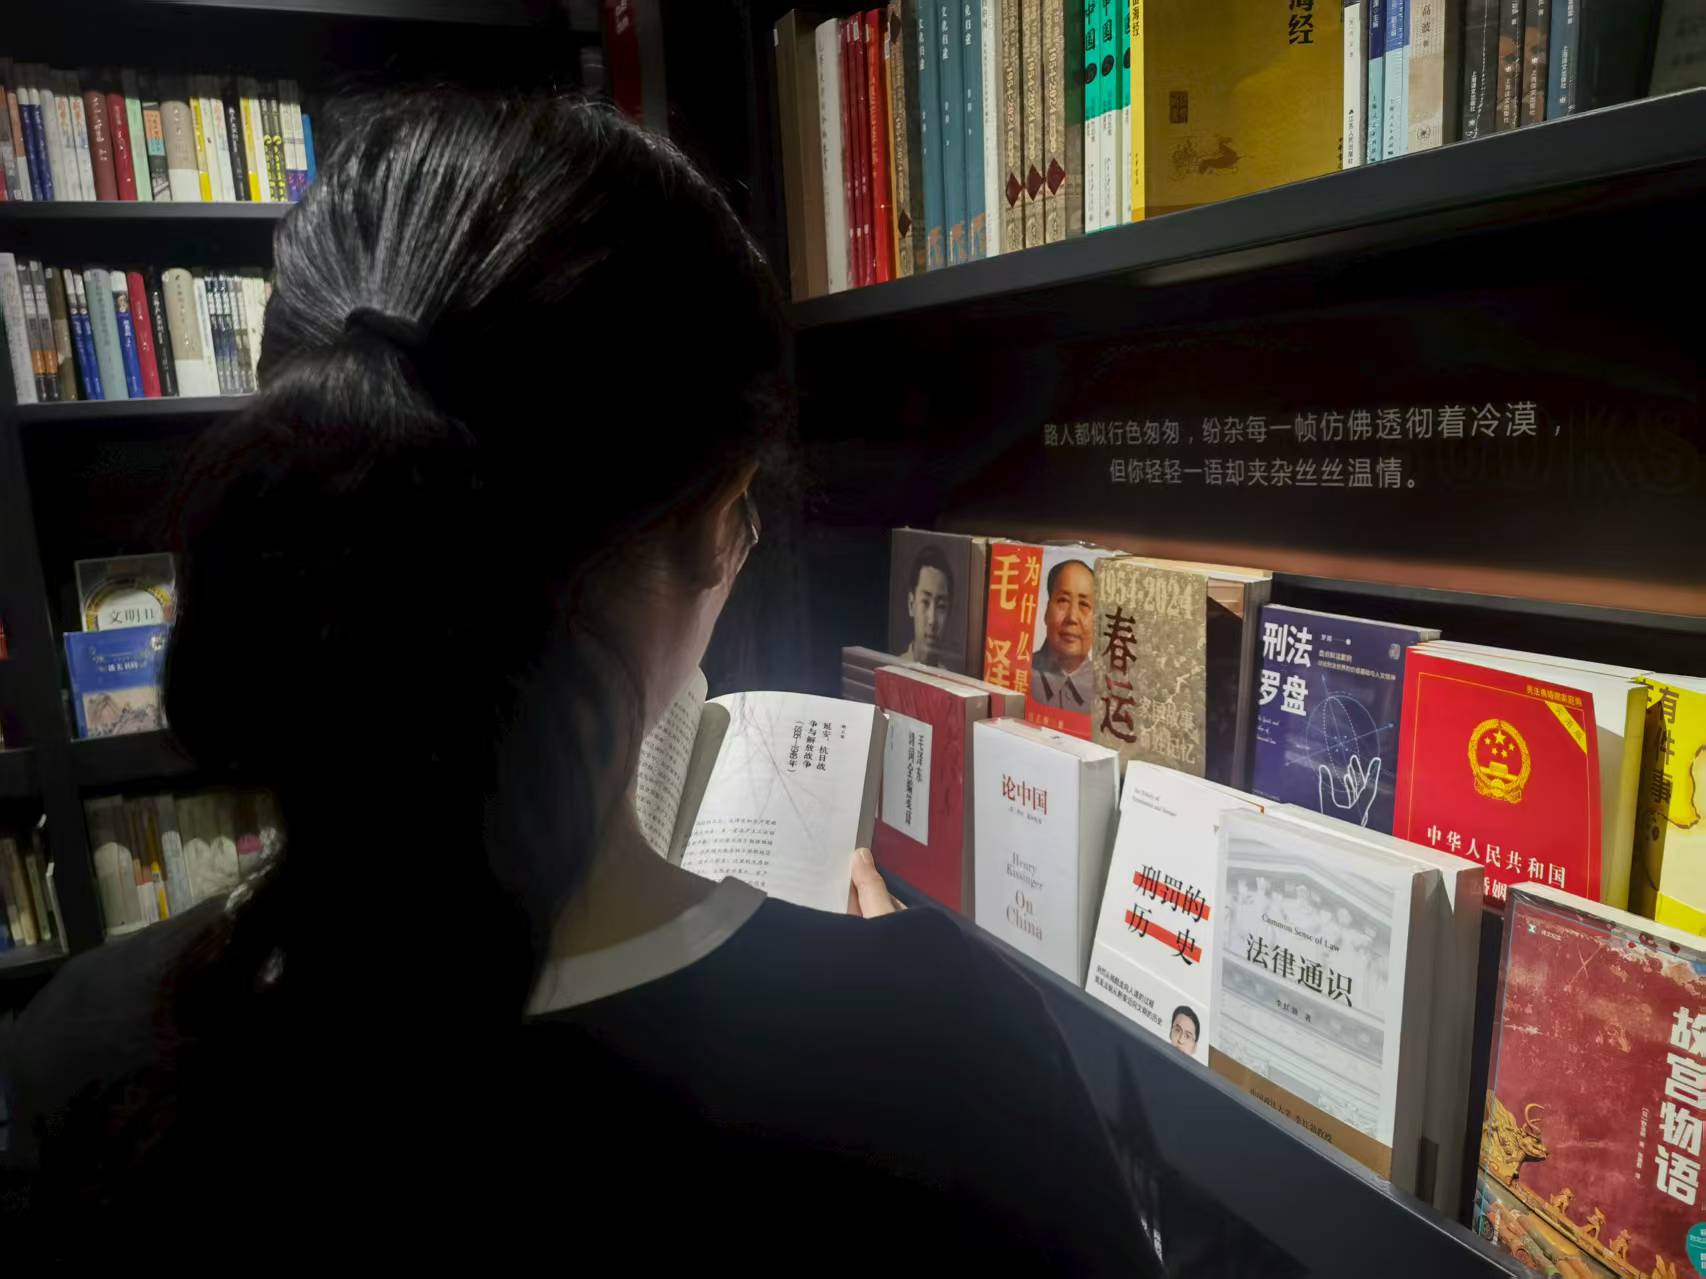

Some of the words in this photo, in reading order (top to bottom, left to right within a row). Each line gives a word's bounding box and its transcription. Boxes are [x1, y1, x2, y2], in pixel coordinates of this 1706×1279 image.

[1109, 457, 1416, 489] 但你轻轻一语却夹杂丝丝温情。
[1013, 556, 1040, 694] 为什么是
[1263, 622, 1313, 668] 刑法
[1101, 605, 1138, 744] 春运
[1259, 669, 1309, 717] 罗盘
[1002, 773, 1049, 816] 论中国
[1427, 825, 1567, 889] 中华人民共和国
[1015, 888, 1034, 915] On
[1136, 864, 1207, 923] 刑罚的
[1006, 904, 1044, 941] China
[1128, 903, 1195, 966] 历史
[1261, 912, 1293, 933] Common
[1294, 927, 1313, 942] Sense
[1314, 935, 1324, 946] of
[1324, 939, 1340, 952] Law
[1246, 932, 1353, 1008] 法律通识
[1654, 1005, 1706, 1206] 故宫物语
